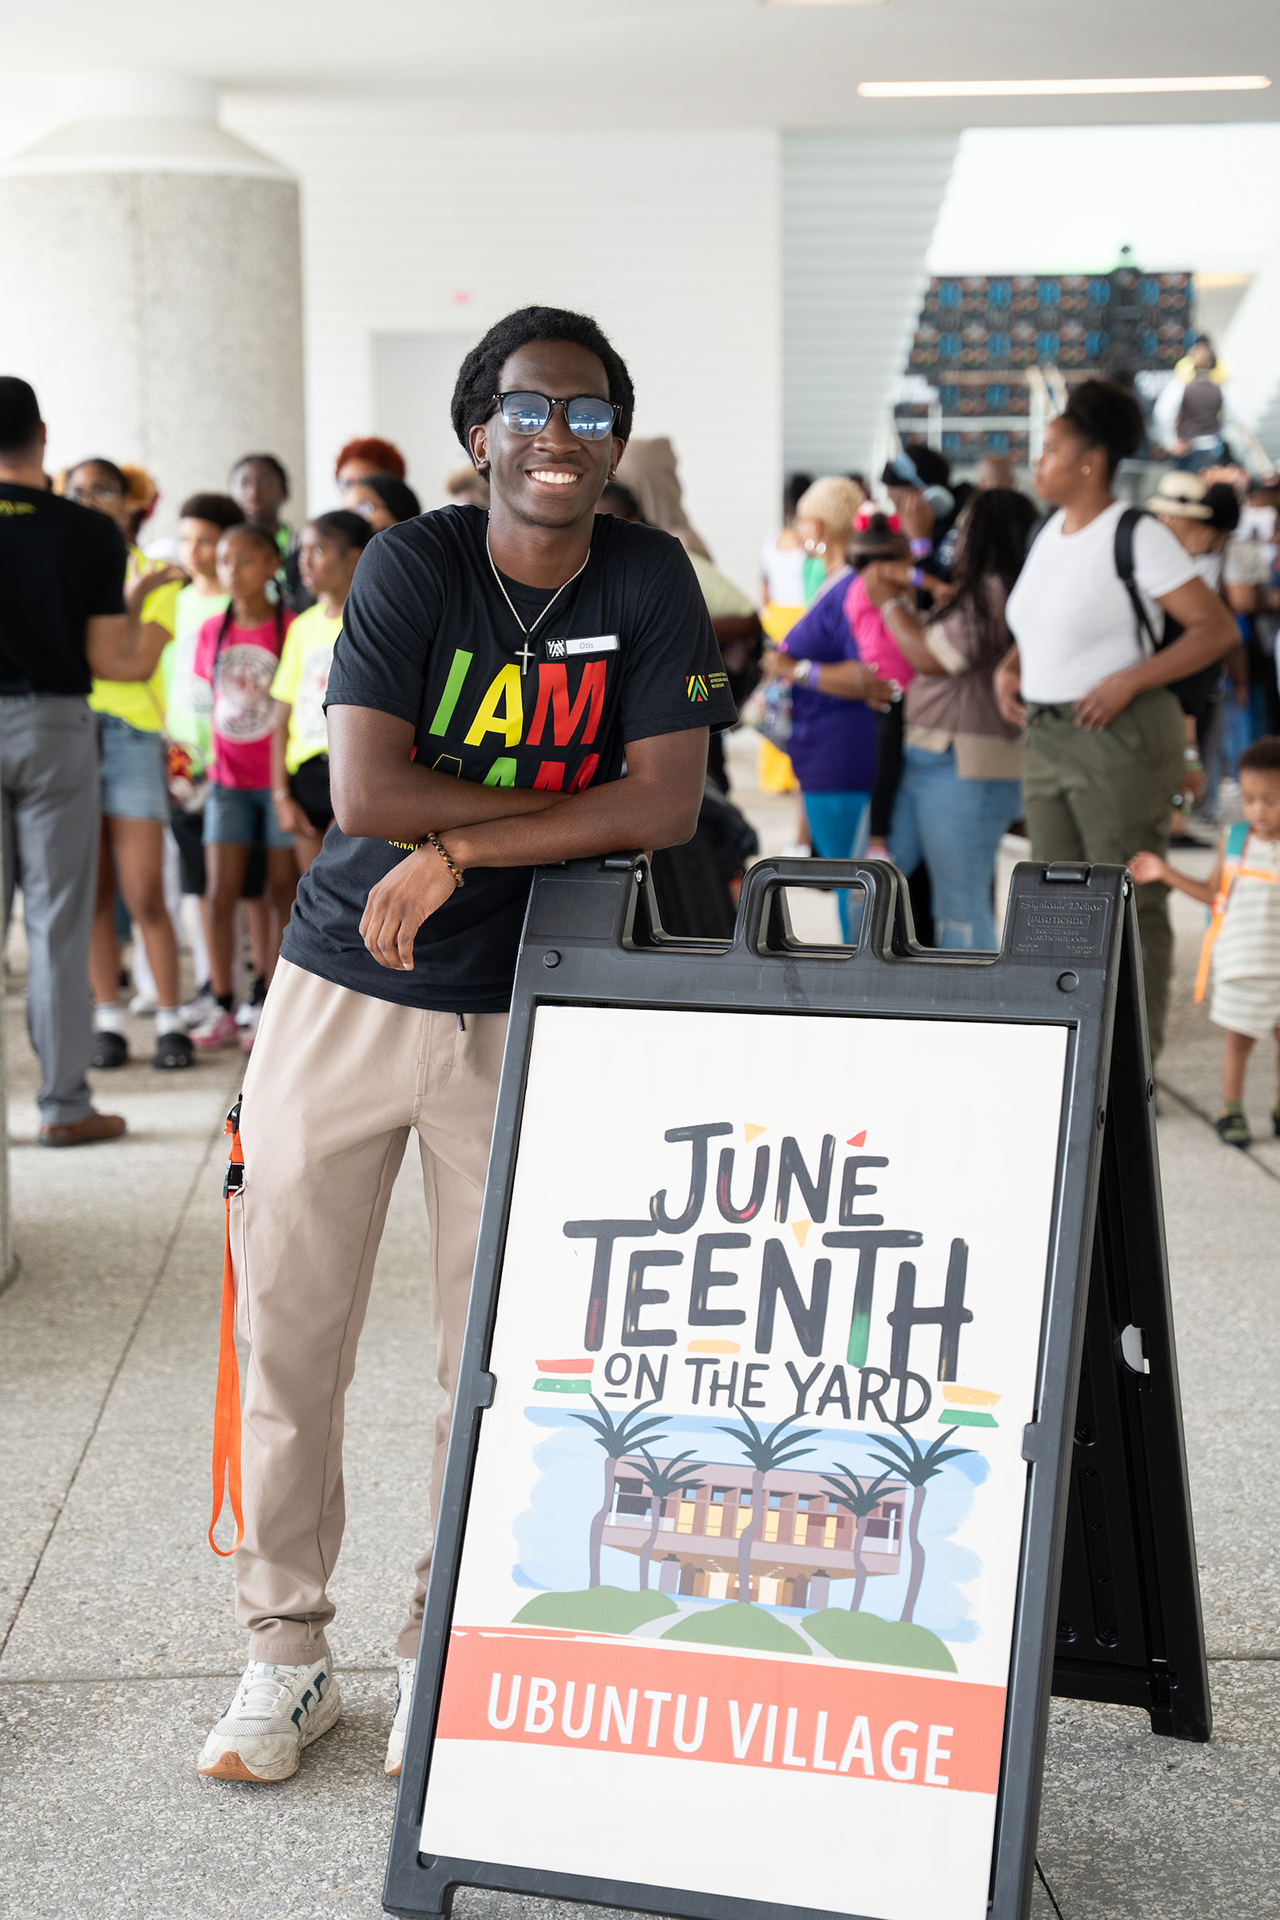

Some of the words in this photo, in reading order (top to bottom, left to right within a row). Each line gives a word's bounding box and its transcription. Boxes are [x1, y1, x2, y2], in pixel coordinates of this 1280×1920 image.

[429, 648, 473, 737] I
[464, 659, 607, 748] AM
[580, 641, 594, 650] Otis
[649, 1122, 889, 1234] JUNE
[562, 1219, 974, 1382] TEENTH
[604, 1353, 668, 1401] ON
[685, 1358, 770, 1408] THE
[785, 1361, 932, 1425] YARD
[487, 1672, 708, 1753] UBUNTU
[728, 1699, 954, 1786] VILLAGE
